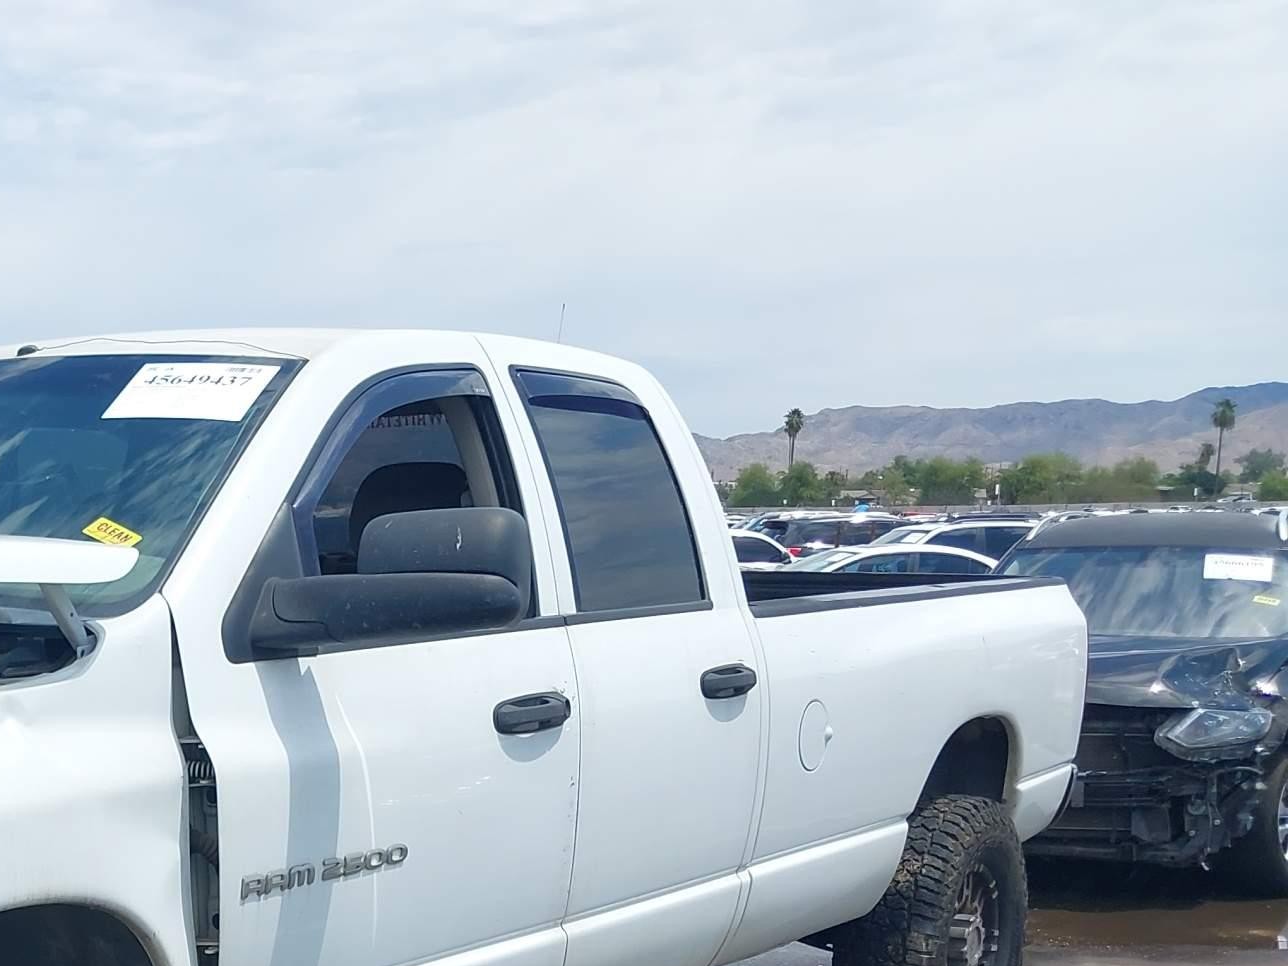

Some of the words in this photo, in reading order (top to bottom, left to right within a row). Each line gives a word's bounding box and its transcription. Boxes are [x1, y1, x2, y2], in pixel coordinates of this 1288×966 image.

[144, 375, 253, 386] 45649437
[97, 522, 133, 542] CLEAN
[240, 862, 315, 902] RAM
[322, 843, 409, 882] 2500
